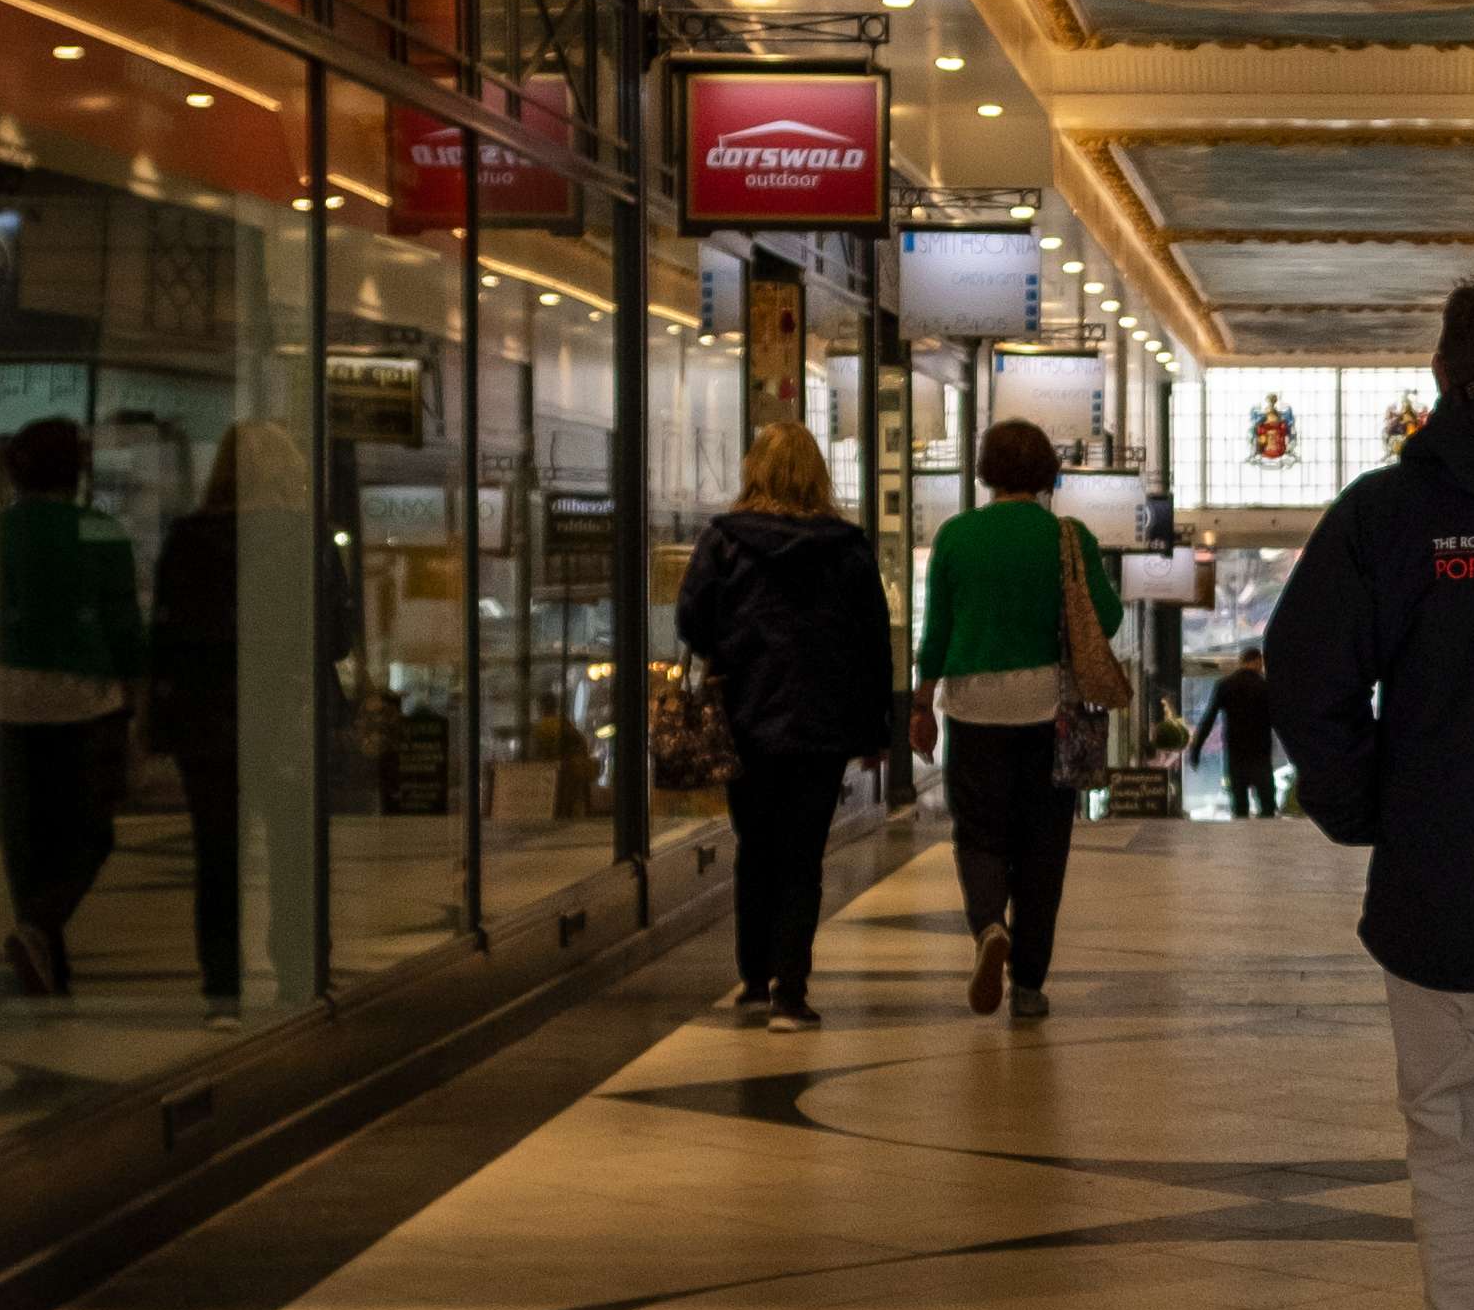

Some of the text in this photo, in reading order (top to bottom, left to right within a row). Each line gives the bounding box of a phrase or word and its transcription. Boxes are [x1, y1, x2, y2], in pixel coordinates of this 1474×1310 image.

[706, 146, 867, 172] COTSWOLD
[744, 170, 821, 190] outdoor
[1433, 538, 1457, 550] THE
